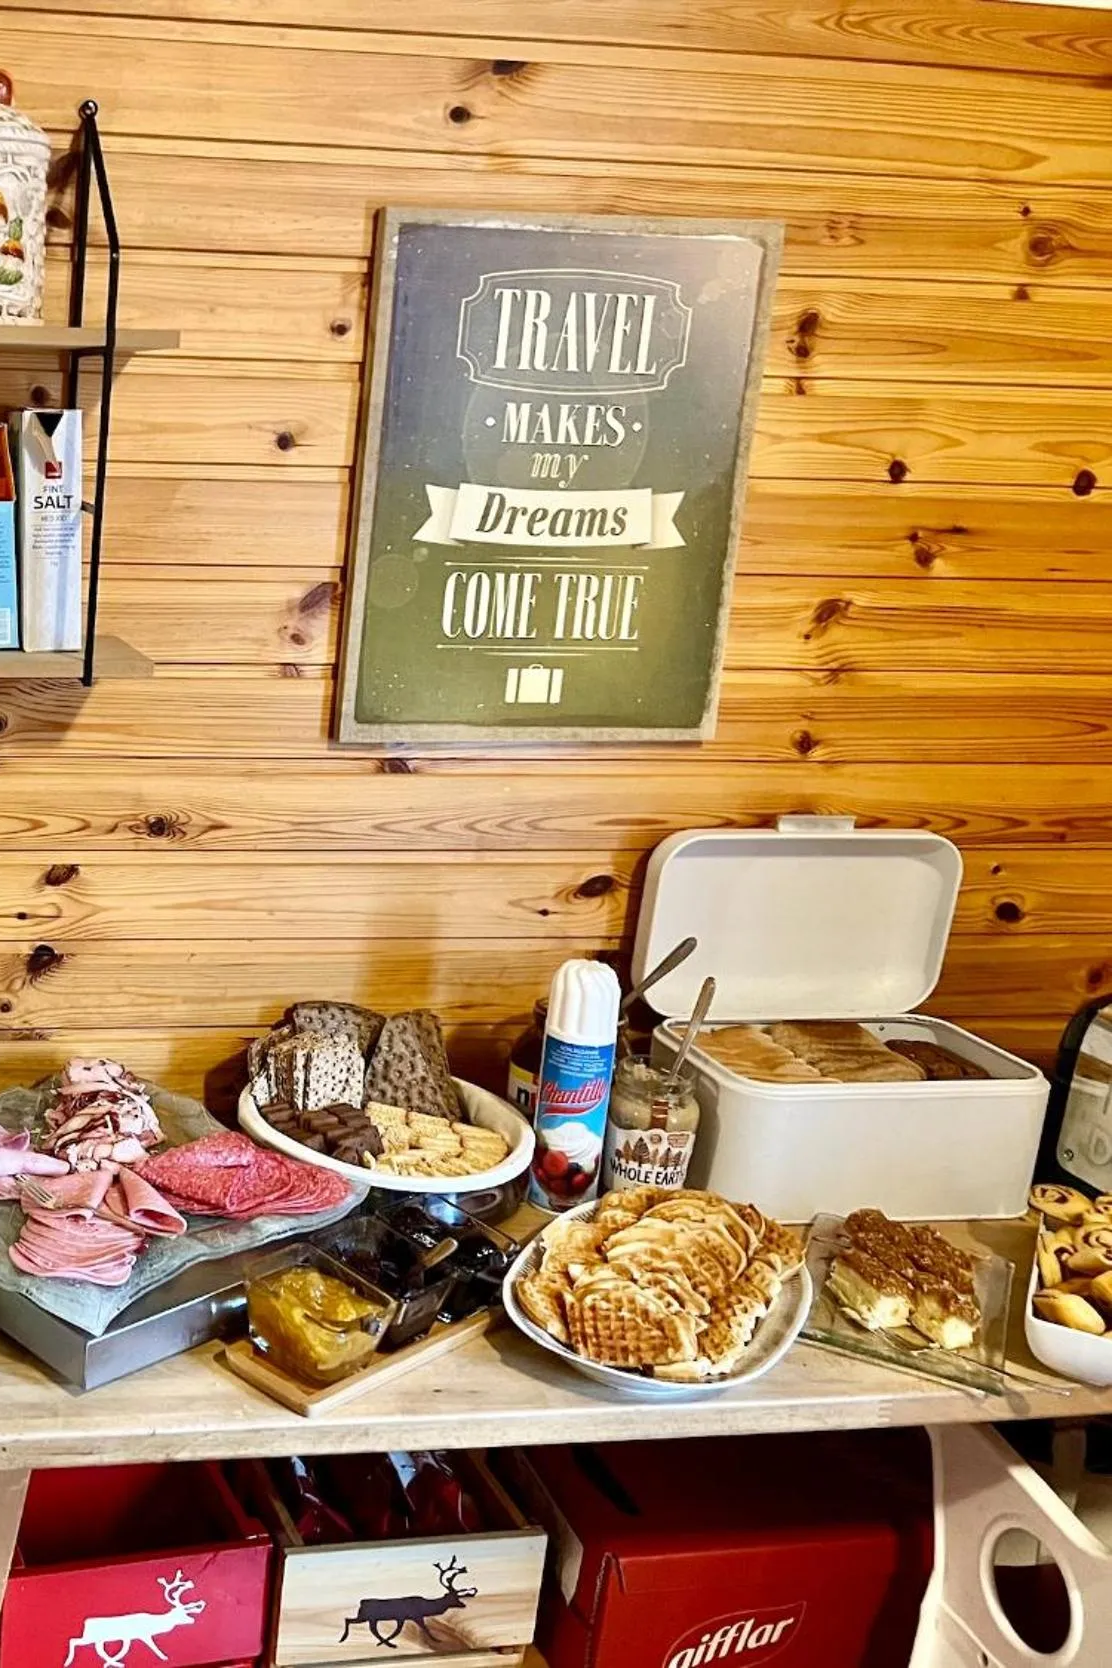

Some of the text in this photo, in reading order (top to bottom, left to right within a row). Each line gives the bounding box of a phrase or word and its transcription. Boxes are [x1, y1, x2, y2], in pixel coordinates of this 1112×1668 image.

[493, 288, 657, 375] TRAVEL
[501, 402, 626, 447] MAKES
[529, 452, 589, 488] my
[33, 495, 74, 510] SALT
[476, 492, 628, 537] Dreams
[441, 572, 644, 640] COME TRUE
[610, 1158, 651, 1183] WHOLE
